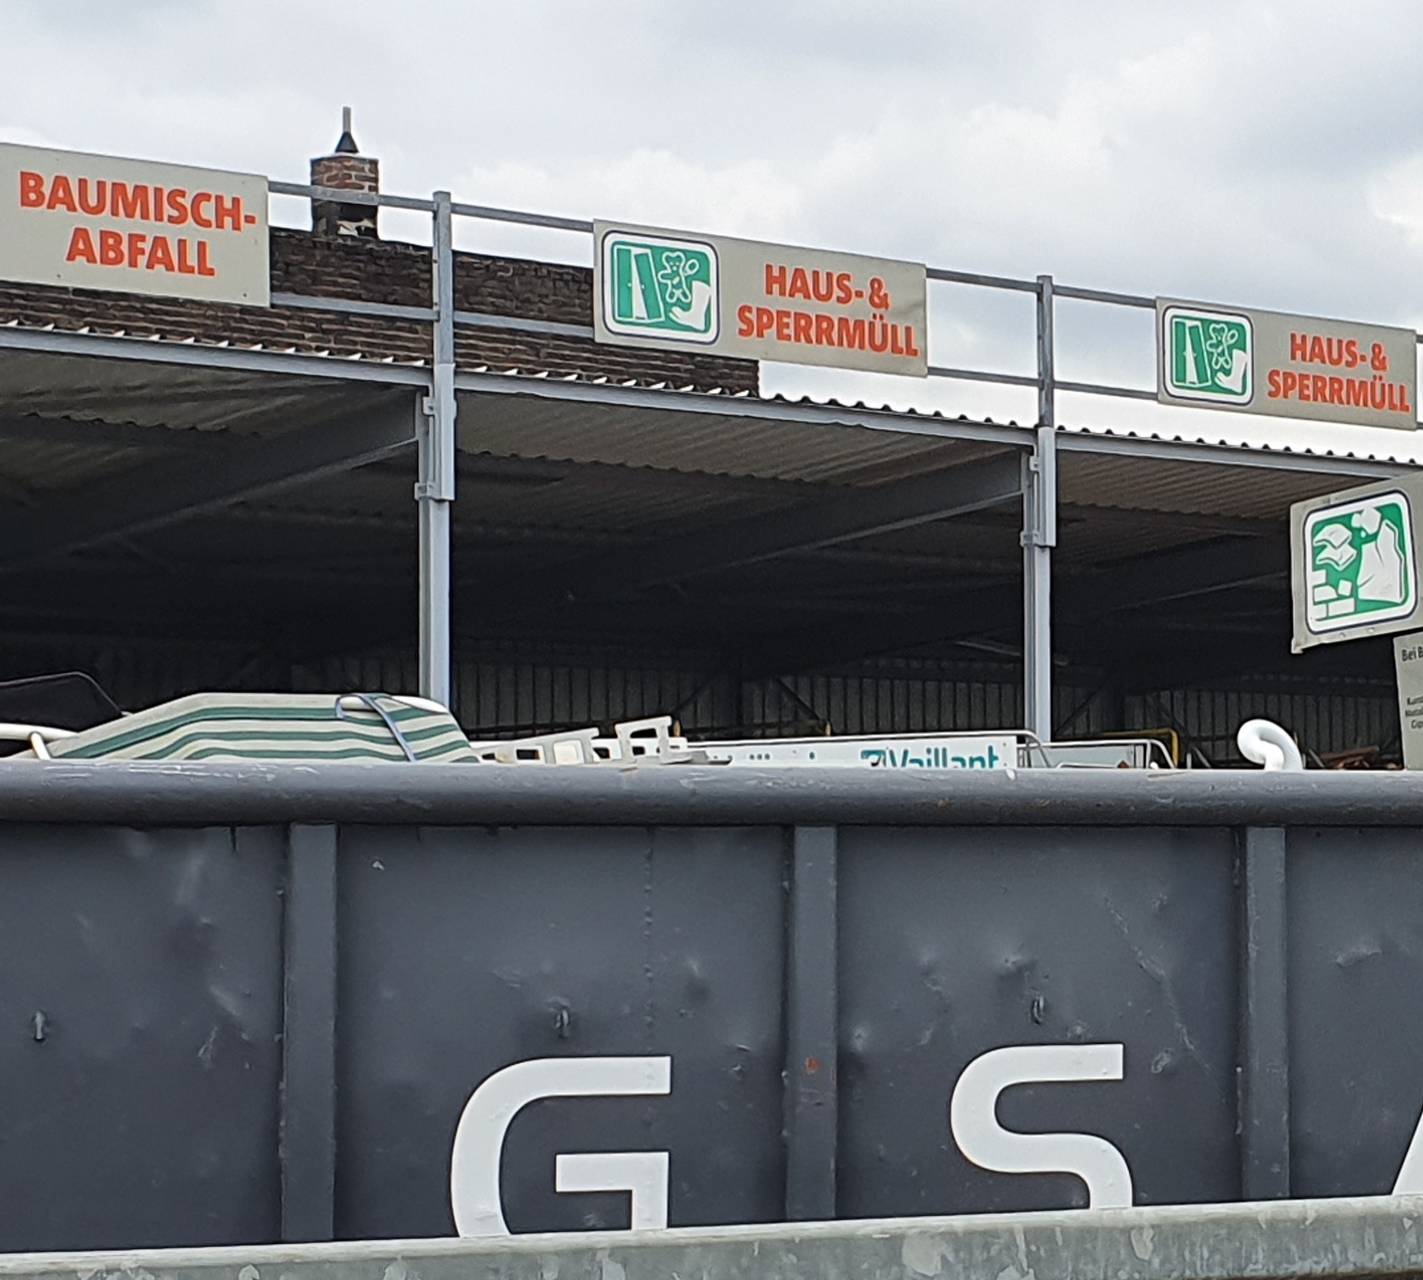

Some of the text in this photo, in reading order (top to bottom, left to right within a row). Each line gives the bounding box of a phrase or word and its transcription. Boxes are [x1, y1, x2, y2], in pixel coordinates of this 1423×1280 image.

[19, 170, 257, 232] BAUMISCH-
[65, 227, 216, 278] ABFALL
[736, 303, 920, 358] SPERRMÜLL
[1267, 368, 1411, 414] SPERRMÜLL
[1402, 646, 1416, 661] Bei
[889, 745, 998, 768] Vaillant
